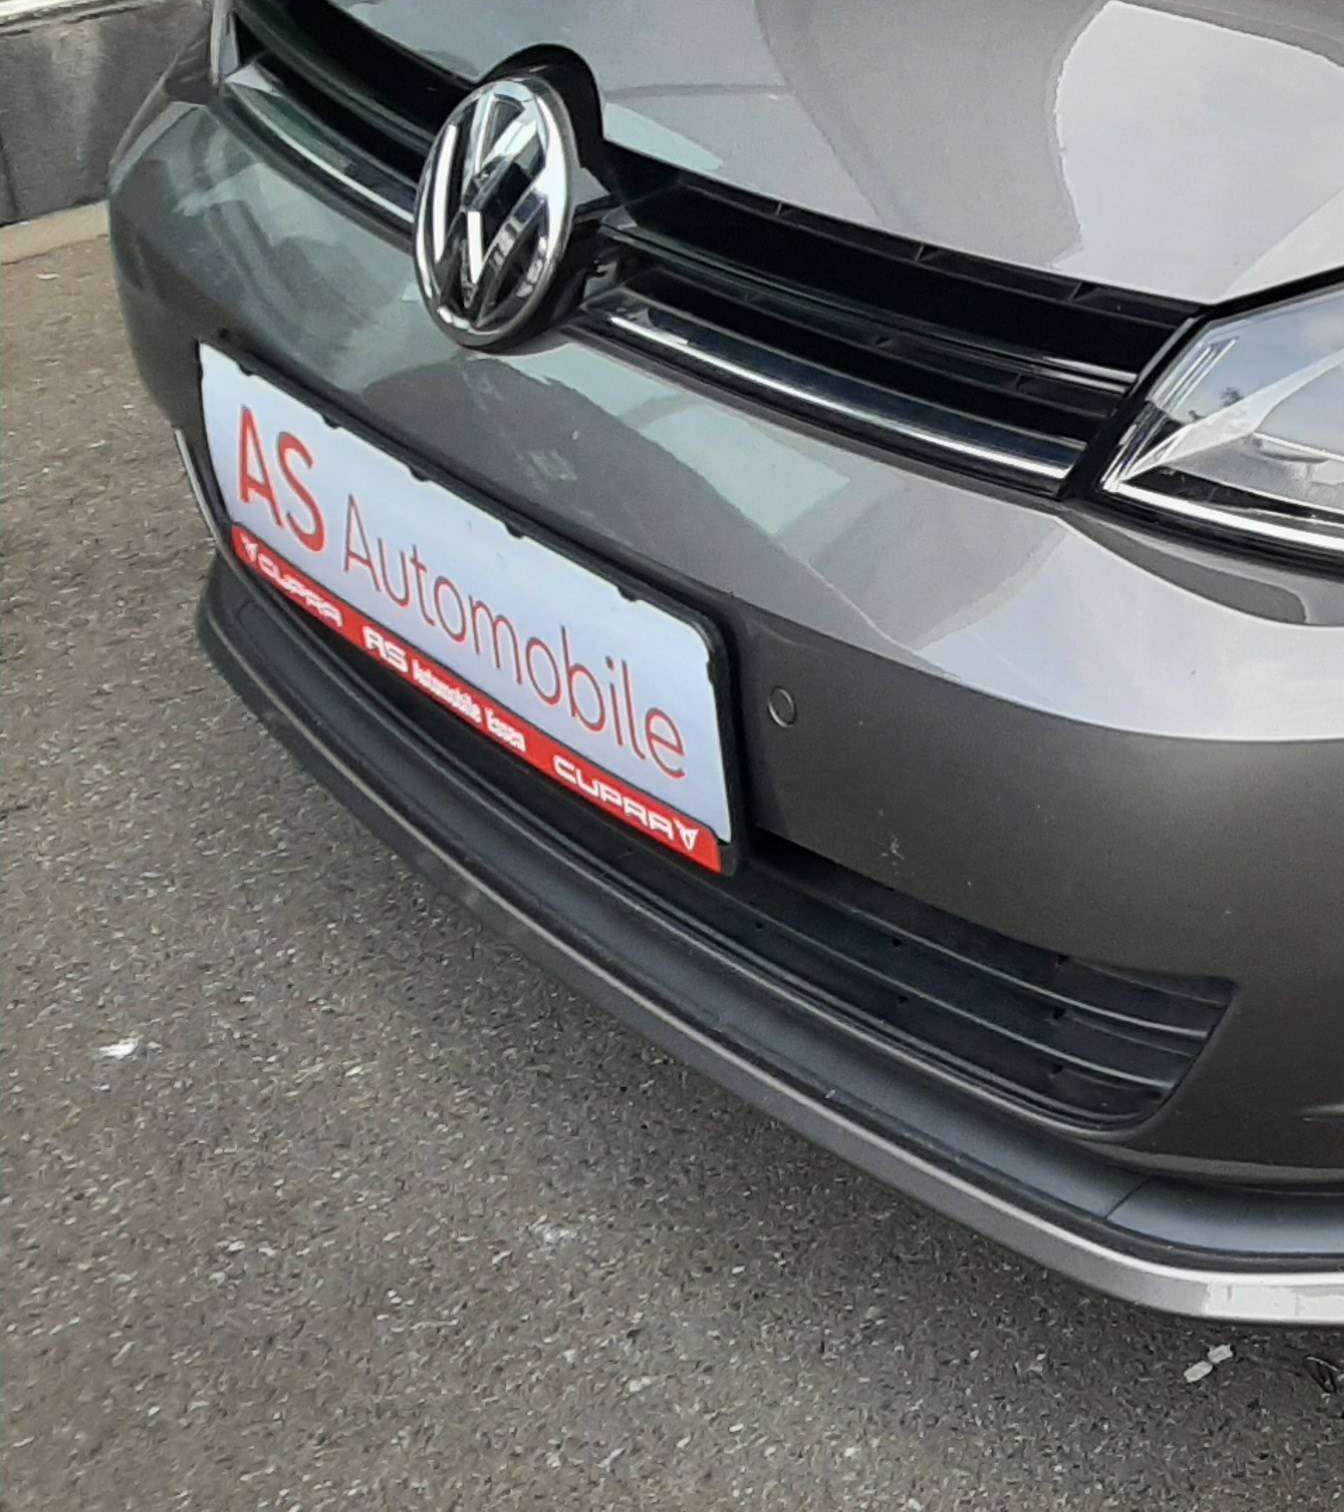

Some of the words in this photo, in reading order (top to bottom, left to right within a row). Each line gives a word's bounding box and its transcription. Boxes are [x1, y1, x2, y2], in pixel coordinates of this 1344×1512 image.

[239, 403, 326, 553] AS
[343, 492, 686, 780] Automobile
[257, 552, 345, 628] CUPRA
[362, 624, 409, 673] AS
[553, 754, 675, 841] CUPRA
